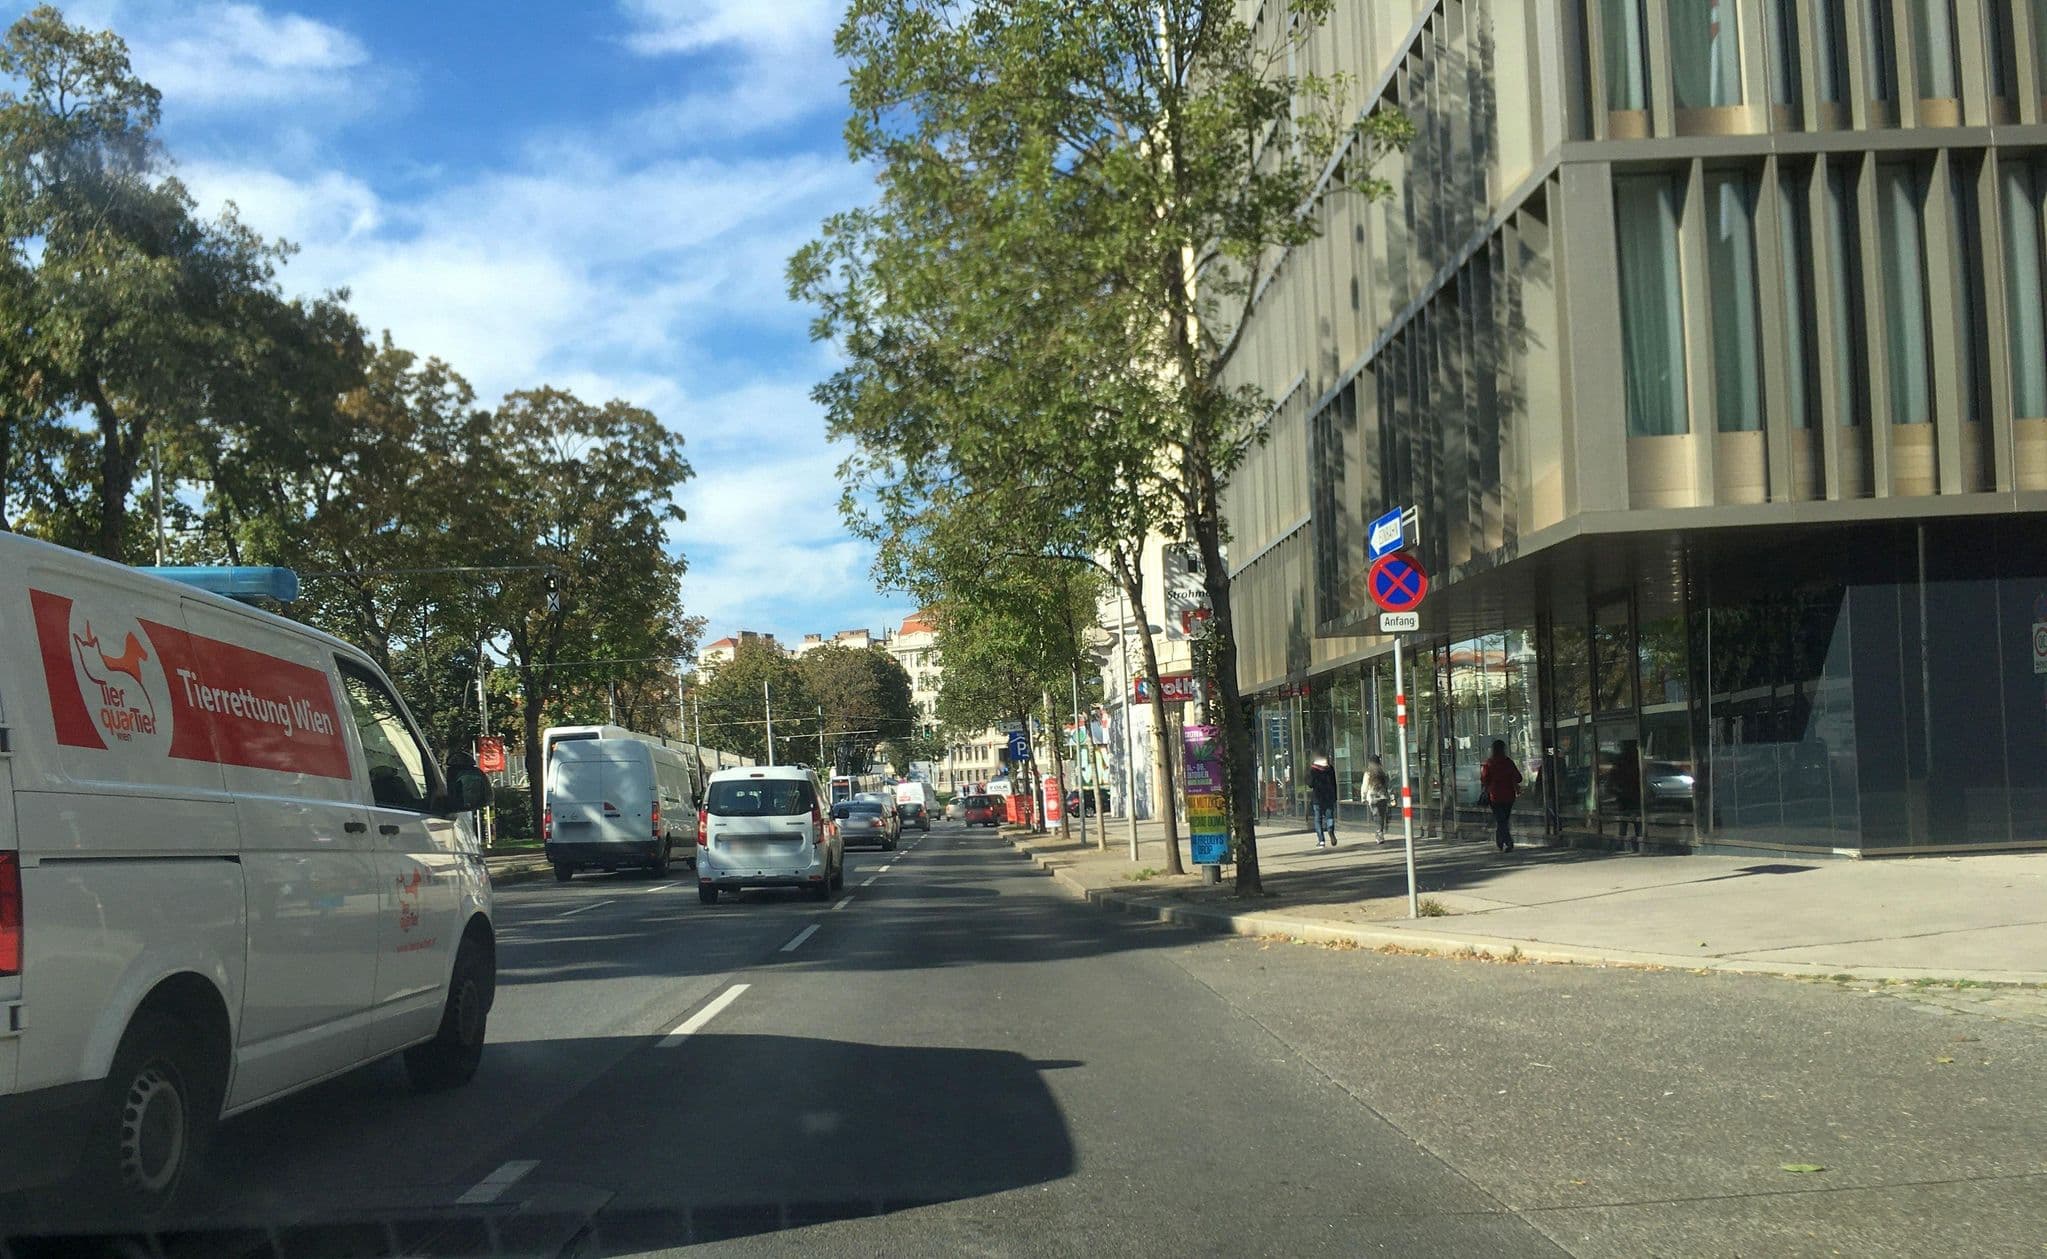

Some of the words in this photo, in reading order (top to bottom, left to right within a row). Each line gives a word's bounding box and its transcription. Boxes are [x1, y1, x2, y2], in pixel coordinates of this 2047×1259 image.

[1384, 616, 1415, 627] Anfang
[97, 681, 126, 708] Tier
[175, 667, 294, 737] Tierrettung
[287, 695, 334, 736] Wien
[1017, 742, 1026, 755] P
